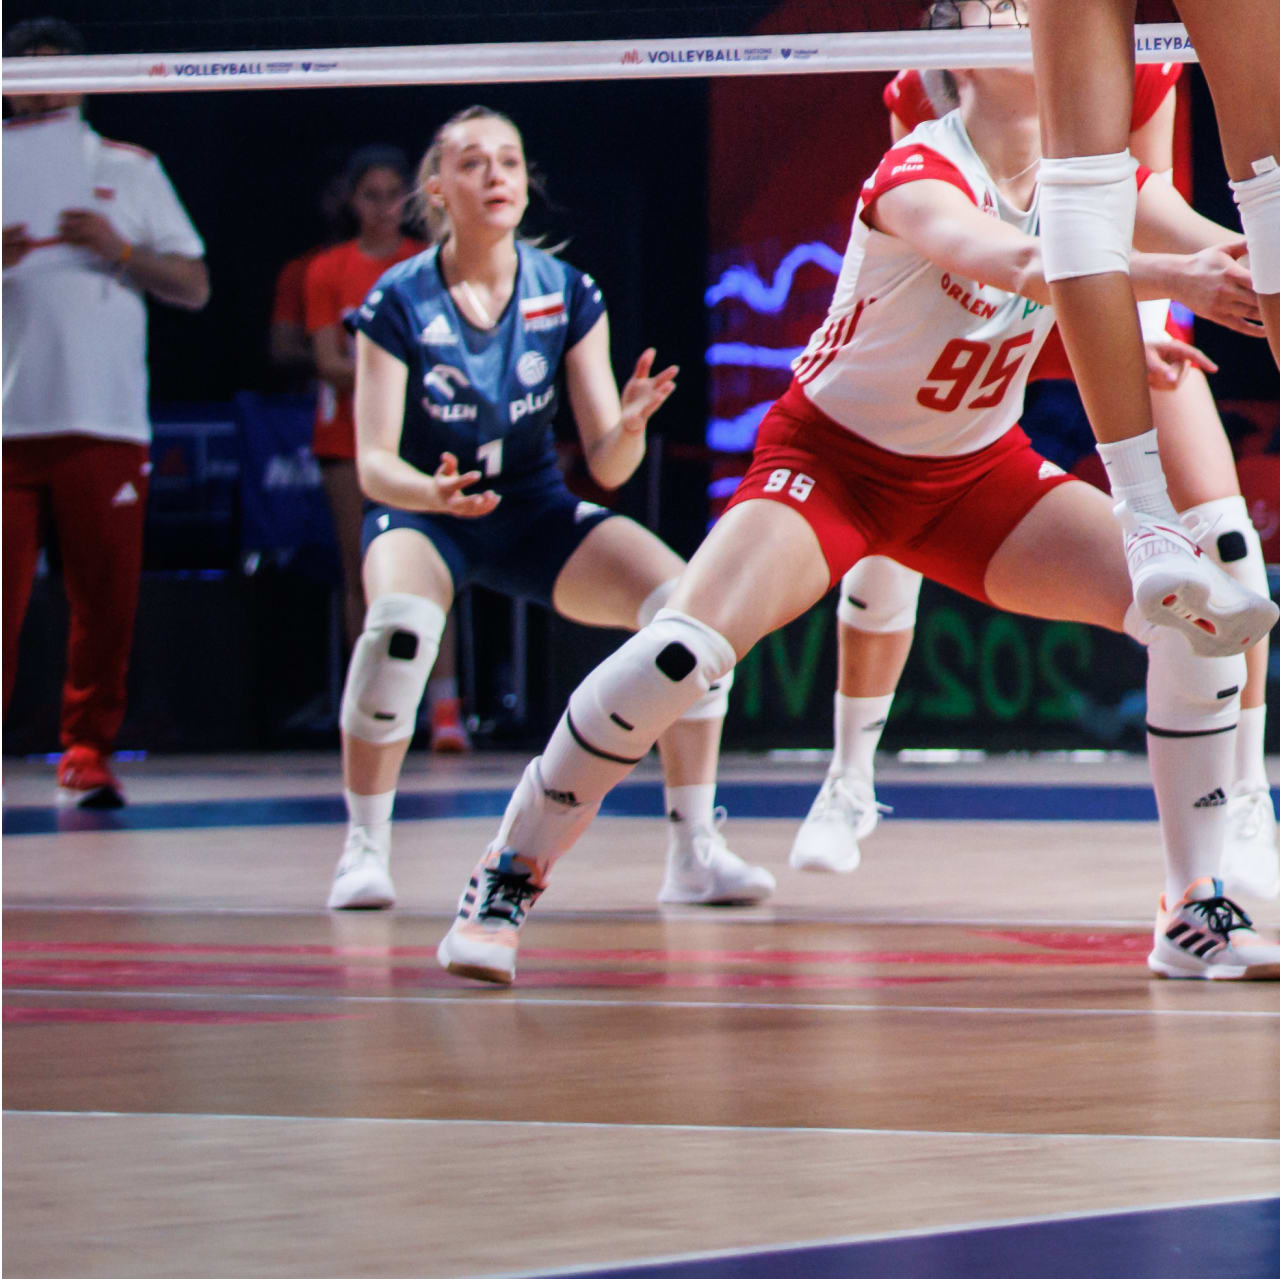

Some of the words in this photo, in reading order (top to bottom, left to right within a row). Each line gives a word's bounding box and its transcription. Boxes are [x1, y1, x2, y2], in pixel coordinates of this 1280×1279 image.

[1135, 36, 1195, 51] LLEYBA
[174, 62, 263, 76] VOLLEYBALL
[648, 49, 742, 64] VOLLEYBALL
[940, 272, 998, 320] ORLEN
[916, 329, 1035, 412] 95
[763, 468, 817, 504] 95
